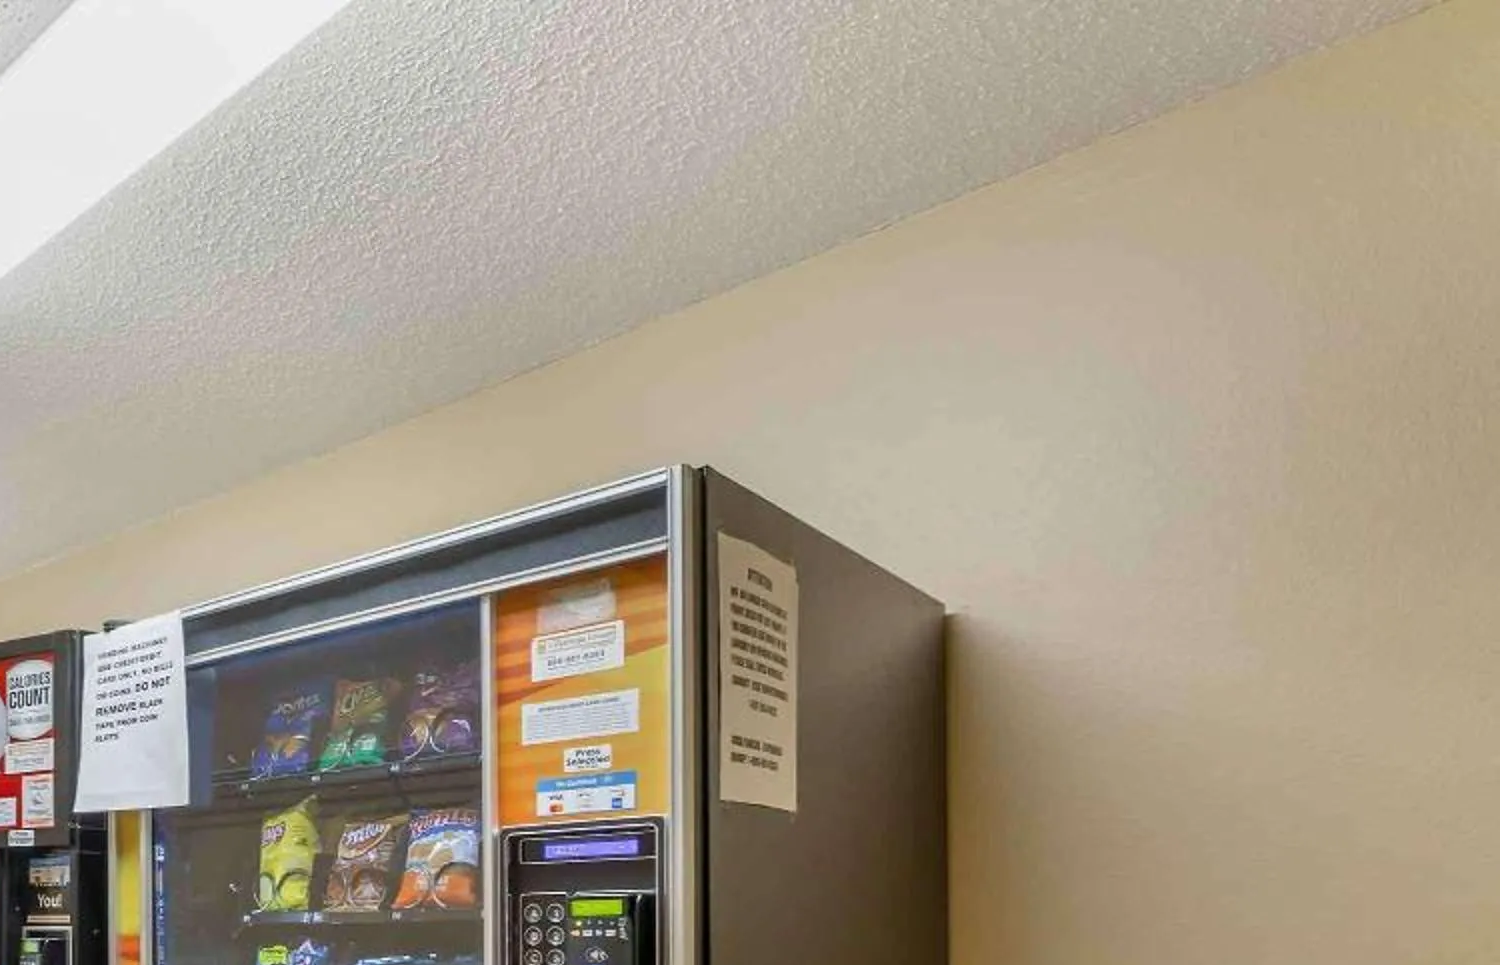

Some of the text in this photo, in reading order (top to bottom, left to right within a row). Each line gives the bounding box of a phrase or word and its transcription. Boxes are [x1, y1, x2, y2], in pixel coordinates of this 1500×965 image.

[8, 671, 51, 691] CALORIES
[134, 681, 149, 693] DO
[151, 675, 171, 688] NOT
[8, 686, 51, 710] COUNT
[94, 700, 137, 717] REMOVE
[36, 893, 62, 909] You!
